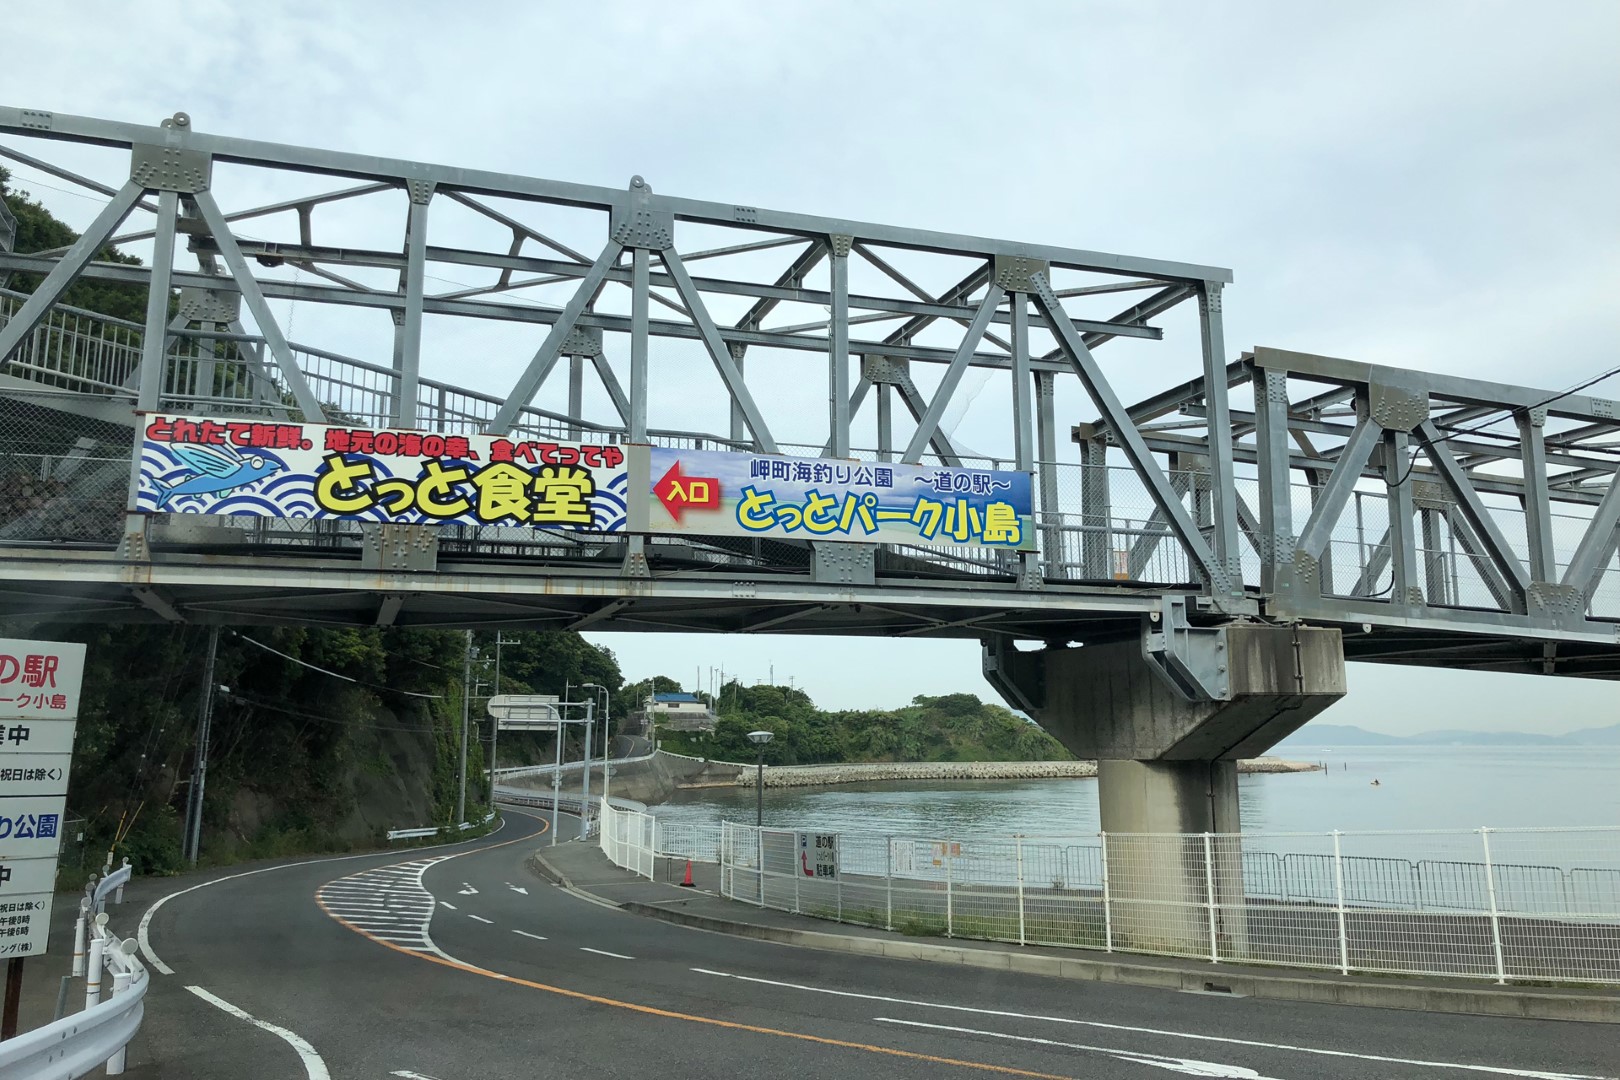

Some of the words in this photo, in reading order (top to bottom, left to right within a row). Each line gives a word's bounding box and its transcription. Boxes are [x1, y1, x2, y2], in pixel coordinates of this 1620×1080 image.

[146, 416, 313, 451] とれたて新鮮。
[325, 429, 481, 460] 地元の海の幸、
[490, 439, 625, 468] 食べてってや
[750, 458, 894, 488] 岬町海釣り公園
[313, 455, 596, 525] とっと食堂
[667, 481, 709, 503] 入口
[736, 484, 1023, 546] とっとパーク小島
[0, 654, 59, 688] の駅
[0, 724, 30, 746] 中
[0, 814, 59, 839] り公園
